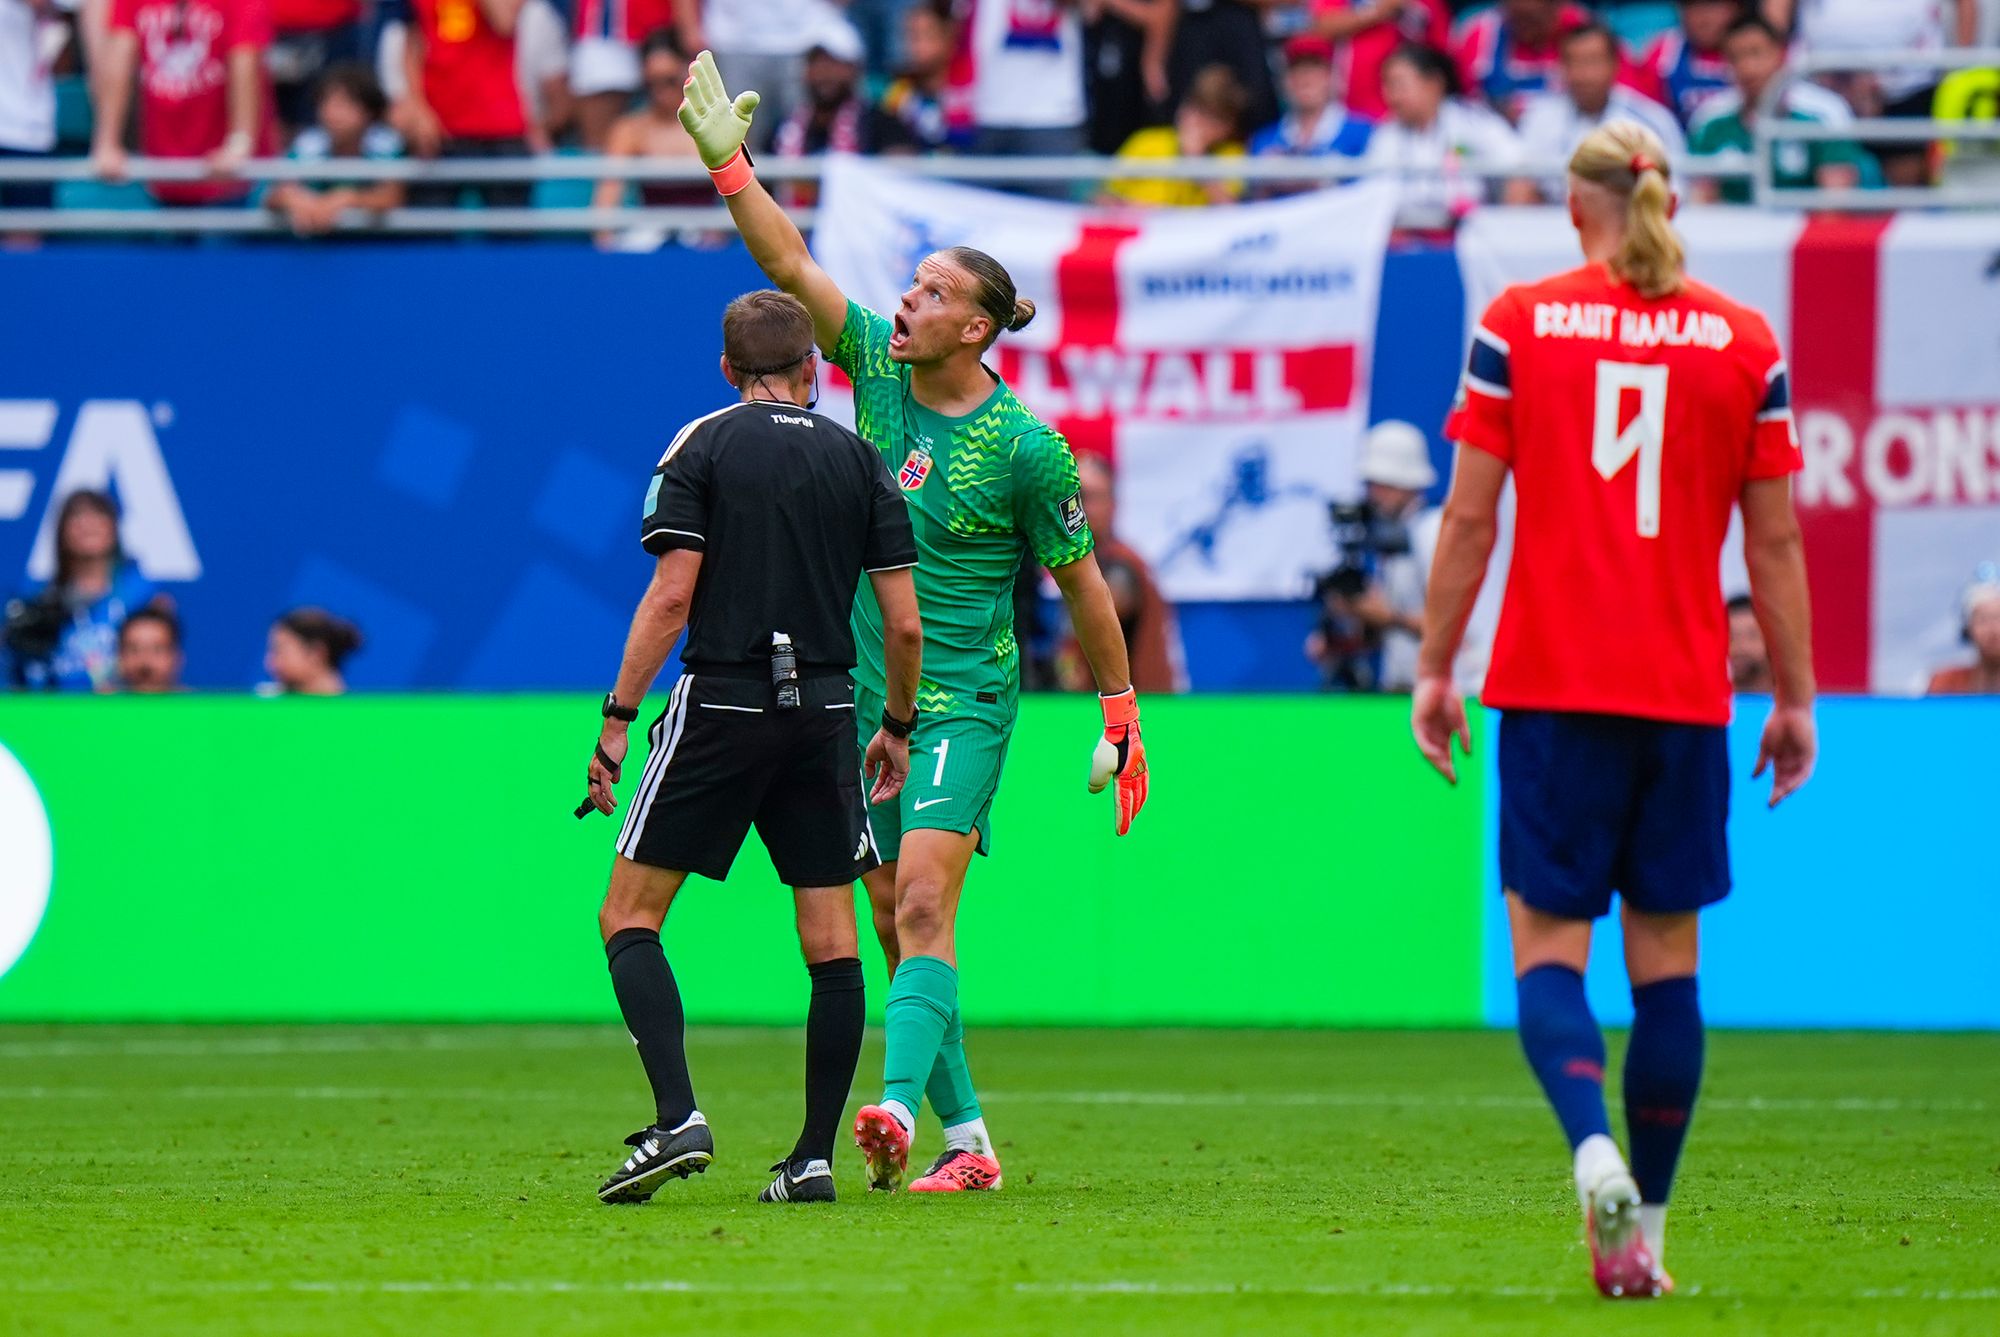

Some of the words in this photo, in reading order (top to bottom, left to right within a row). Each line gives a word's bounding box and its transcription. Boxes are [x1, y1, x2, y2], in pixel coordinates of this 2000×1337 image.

[1534, 301, 1617, 341] BRAUT
[1618, 308, 1734, 352] HAALAND
[978, 346, 1304, 413] LWALL
[770, 414, 815, 428] TURPIN
[1591, 359, 1670, 539] 9
[1799, 409, 2000, 507] RON
[932, 739, 950, 787] 1
